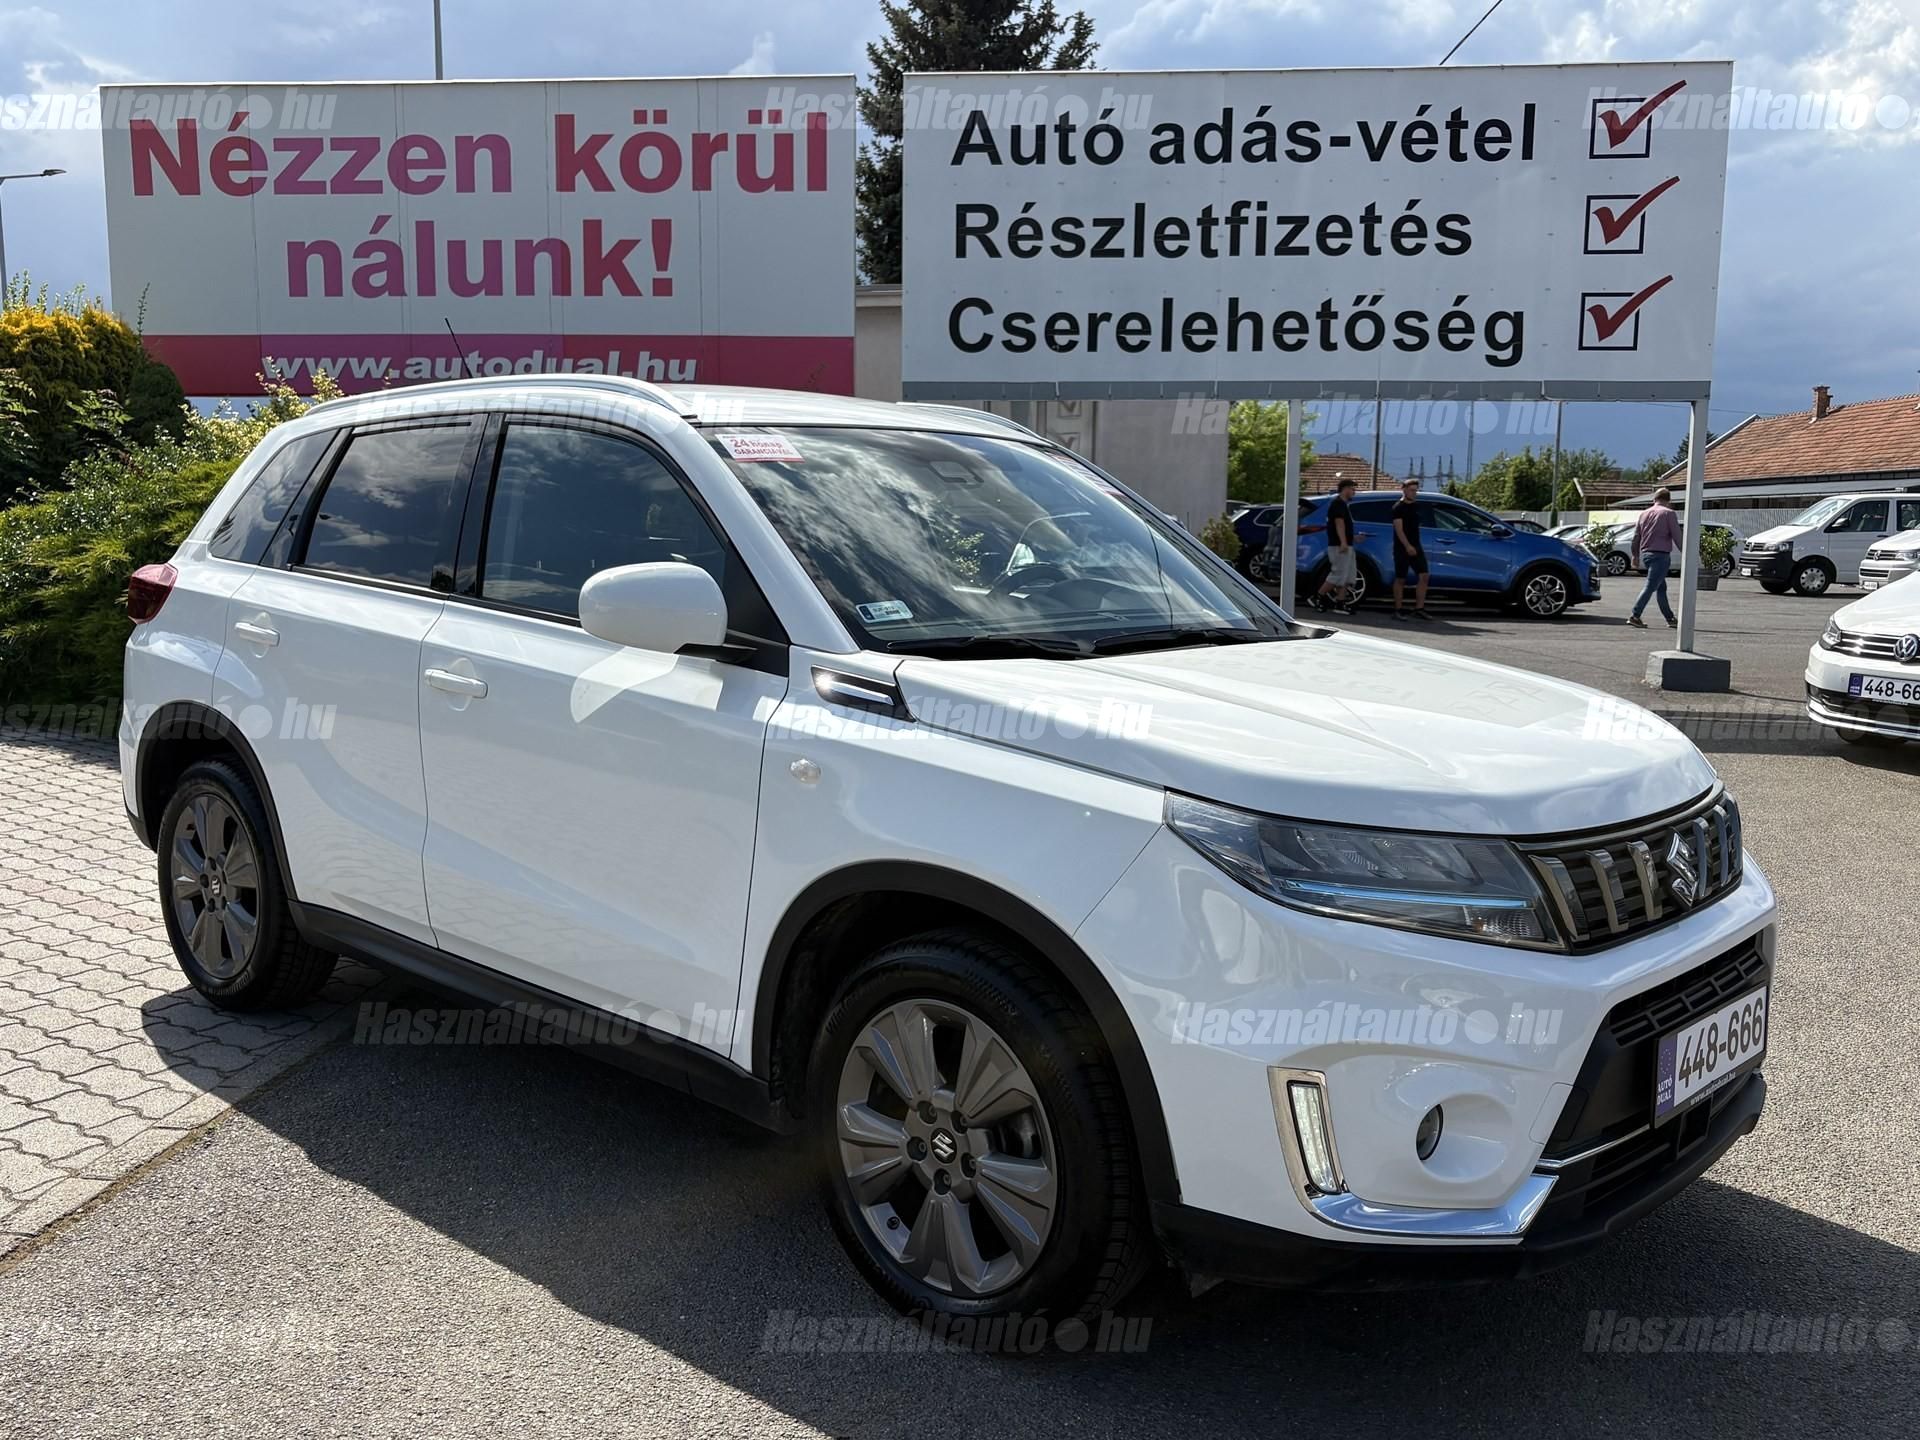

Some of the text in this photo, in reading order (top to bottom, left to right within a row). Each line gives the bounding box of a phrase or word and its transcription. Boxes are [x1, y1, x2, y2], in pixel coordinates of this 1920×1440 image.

[129, 109, 829, 197] Nézzen körül
[950, 102, 1537, 168] Autó adás-vétel
[286, 215, 674, 300] nálunk!
[954, 196, 1474, 260] Részletfizetés
[261, 350, 698, 382] www.autodual.hu
[947, 293, 1526, 369] Cserelehetőség
[1678, 997, 1763, 1089] 448-666
